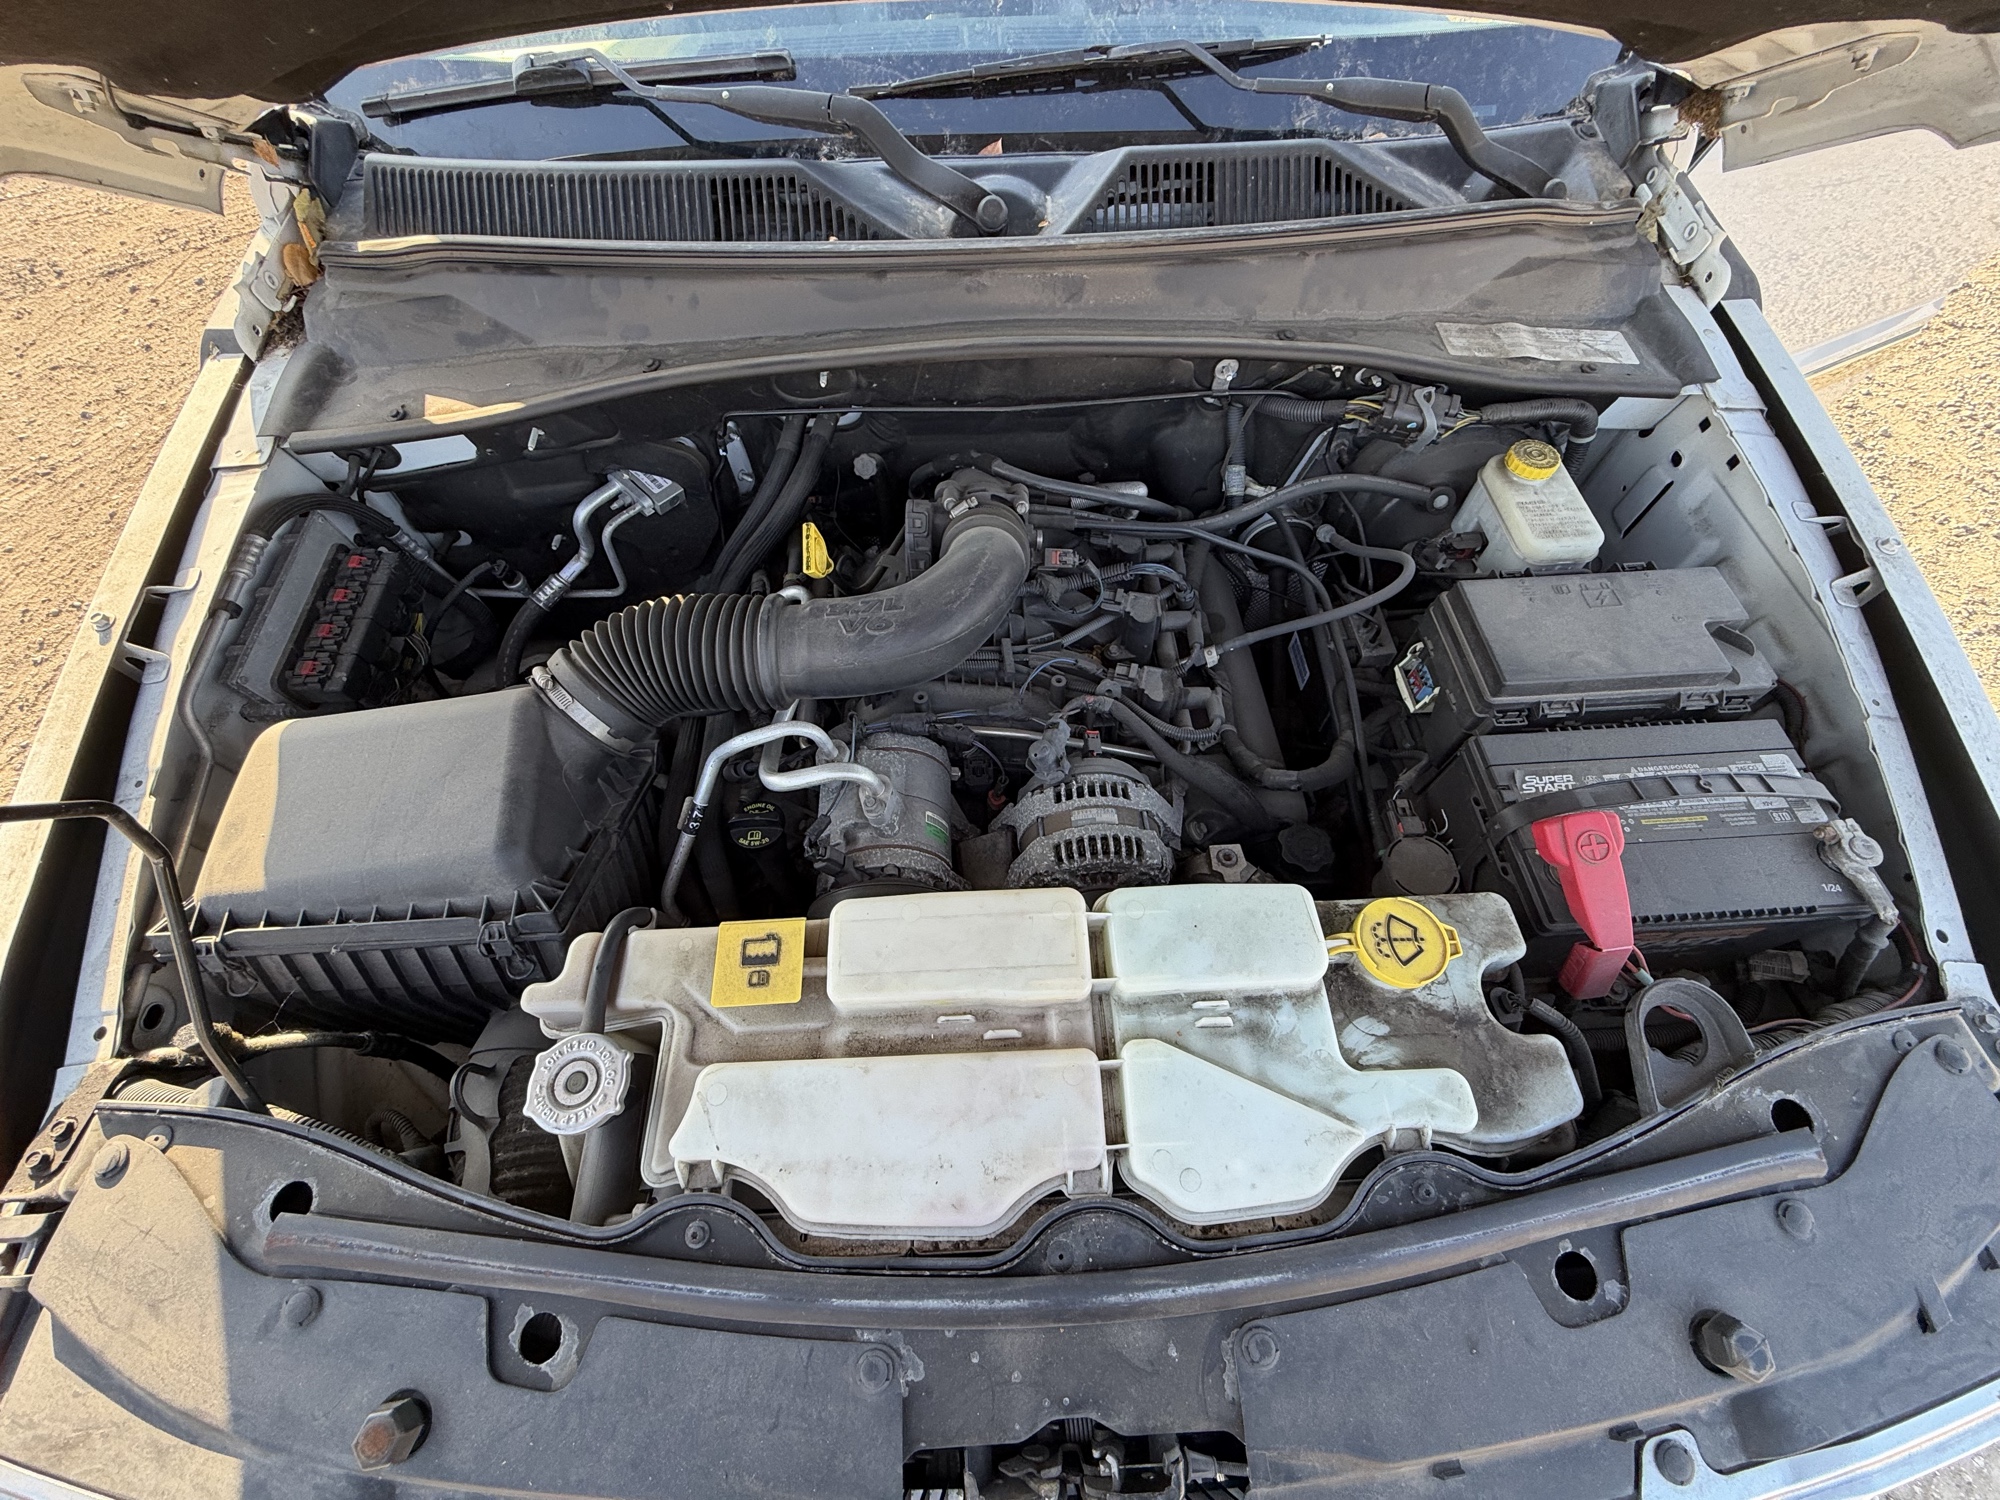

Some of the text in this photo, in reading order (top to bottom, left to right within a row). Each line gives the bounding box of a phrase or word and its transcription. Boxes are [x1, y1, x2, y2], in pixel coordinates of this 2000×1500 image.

[824, 598, 905, 618] 3.7L
[838, 617, 895, 635] V6
[1524, 774, 1574, 785] SUPER
[1522, 783, 1576, 794] START
[743, 803, 776, 812] ENGINE OIL
[1774, 811, 1792, 821] STD
[1821, 883, 1843, 893] 1/24
[563, 1040, 597, 1053] OPEN
[540, 1050, 562, 1074] HOT
[596, 1046, 615, 1068] NOT
[604, 1069, 616, 1087] DO
[533, 1096, 597, 1125] KEEP TIGHT
